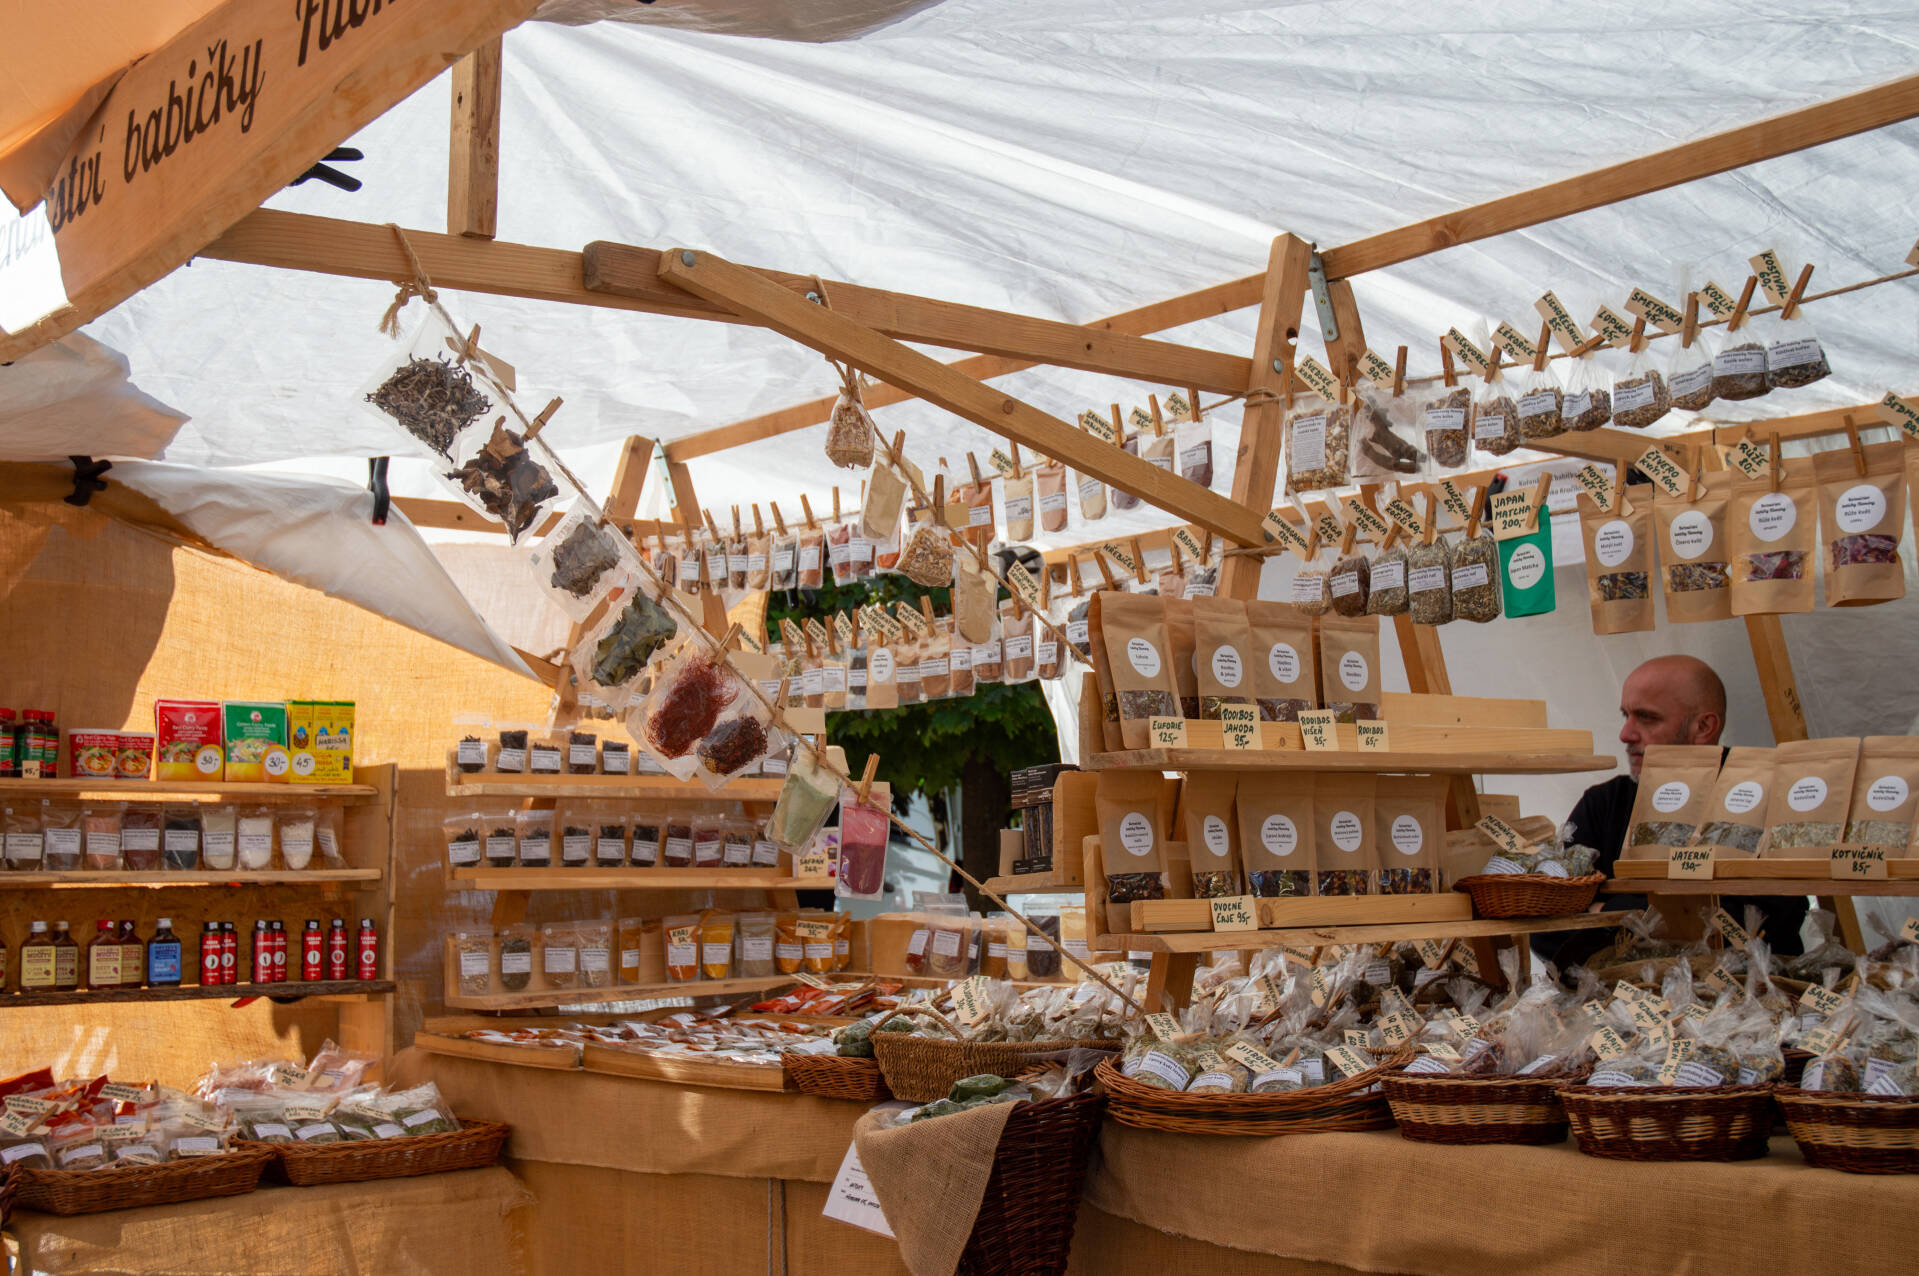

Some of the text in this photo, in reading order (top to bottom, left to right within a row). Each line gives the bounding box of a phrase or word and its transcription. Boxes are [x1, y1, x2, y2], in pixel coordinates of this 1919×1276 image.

[124, 38, 266, 184] babičky
[1760, 252, 1789, 299] KOSTIVAL
[1597, 310, 1633, 337] LOPUCH
[1366, 353, 1392, 378] HOŘEC
[1738, 441, 1769, 468] RŮŽE
[1645, 449, 1680, 479] ČTVERO
[1494, 492, 1525, 509] JAPAN
[1495, 504, 1532, 521] MATCHA
[1502, 518, 1526, 531] 200,-
[1222, 708, 1255, 721] ROOIBOS
[1300, 716, 1331, 726] ROOIBOS
[1152, 720, 1183, 730] EUFORIE
[1223, 722, 1254, 735] JAHODA
[1358, 725, 1384, 735] ROOIBOS
[1672, 847, 1713, 861] JATERNÍ
[1831, 846, 1884, 861] KOTVIČNÍK
[1681, 861, 1702, 872] 130,-
[1213, 897, 1243, 911] OVOCNÉ
[1216, 912, 1234, 924] ČAJE
[1237, 1045, 1279, 1070] JITROCEL
